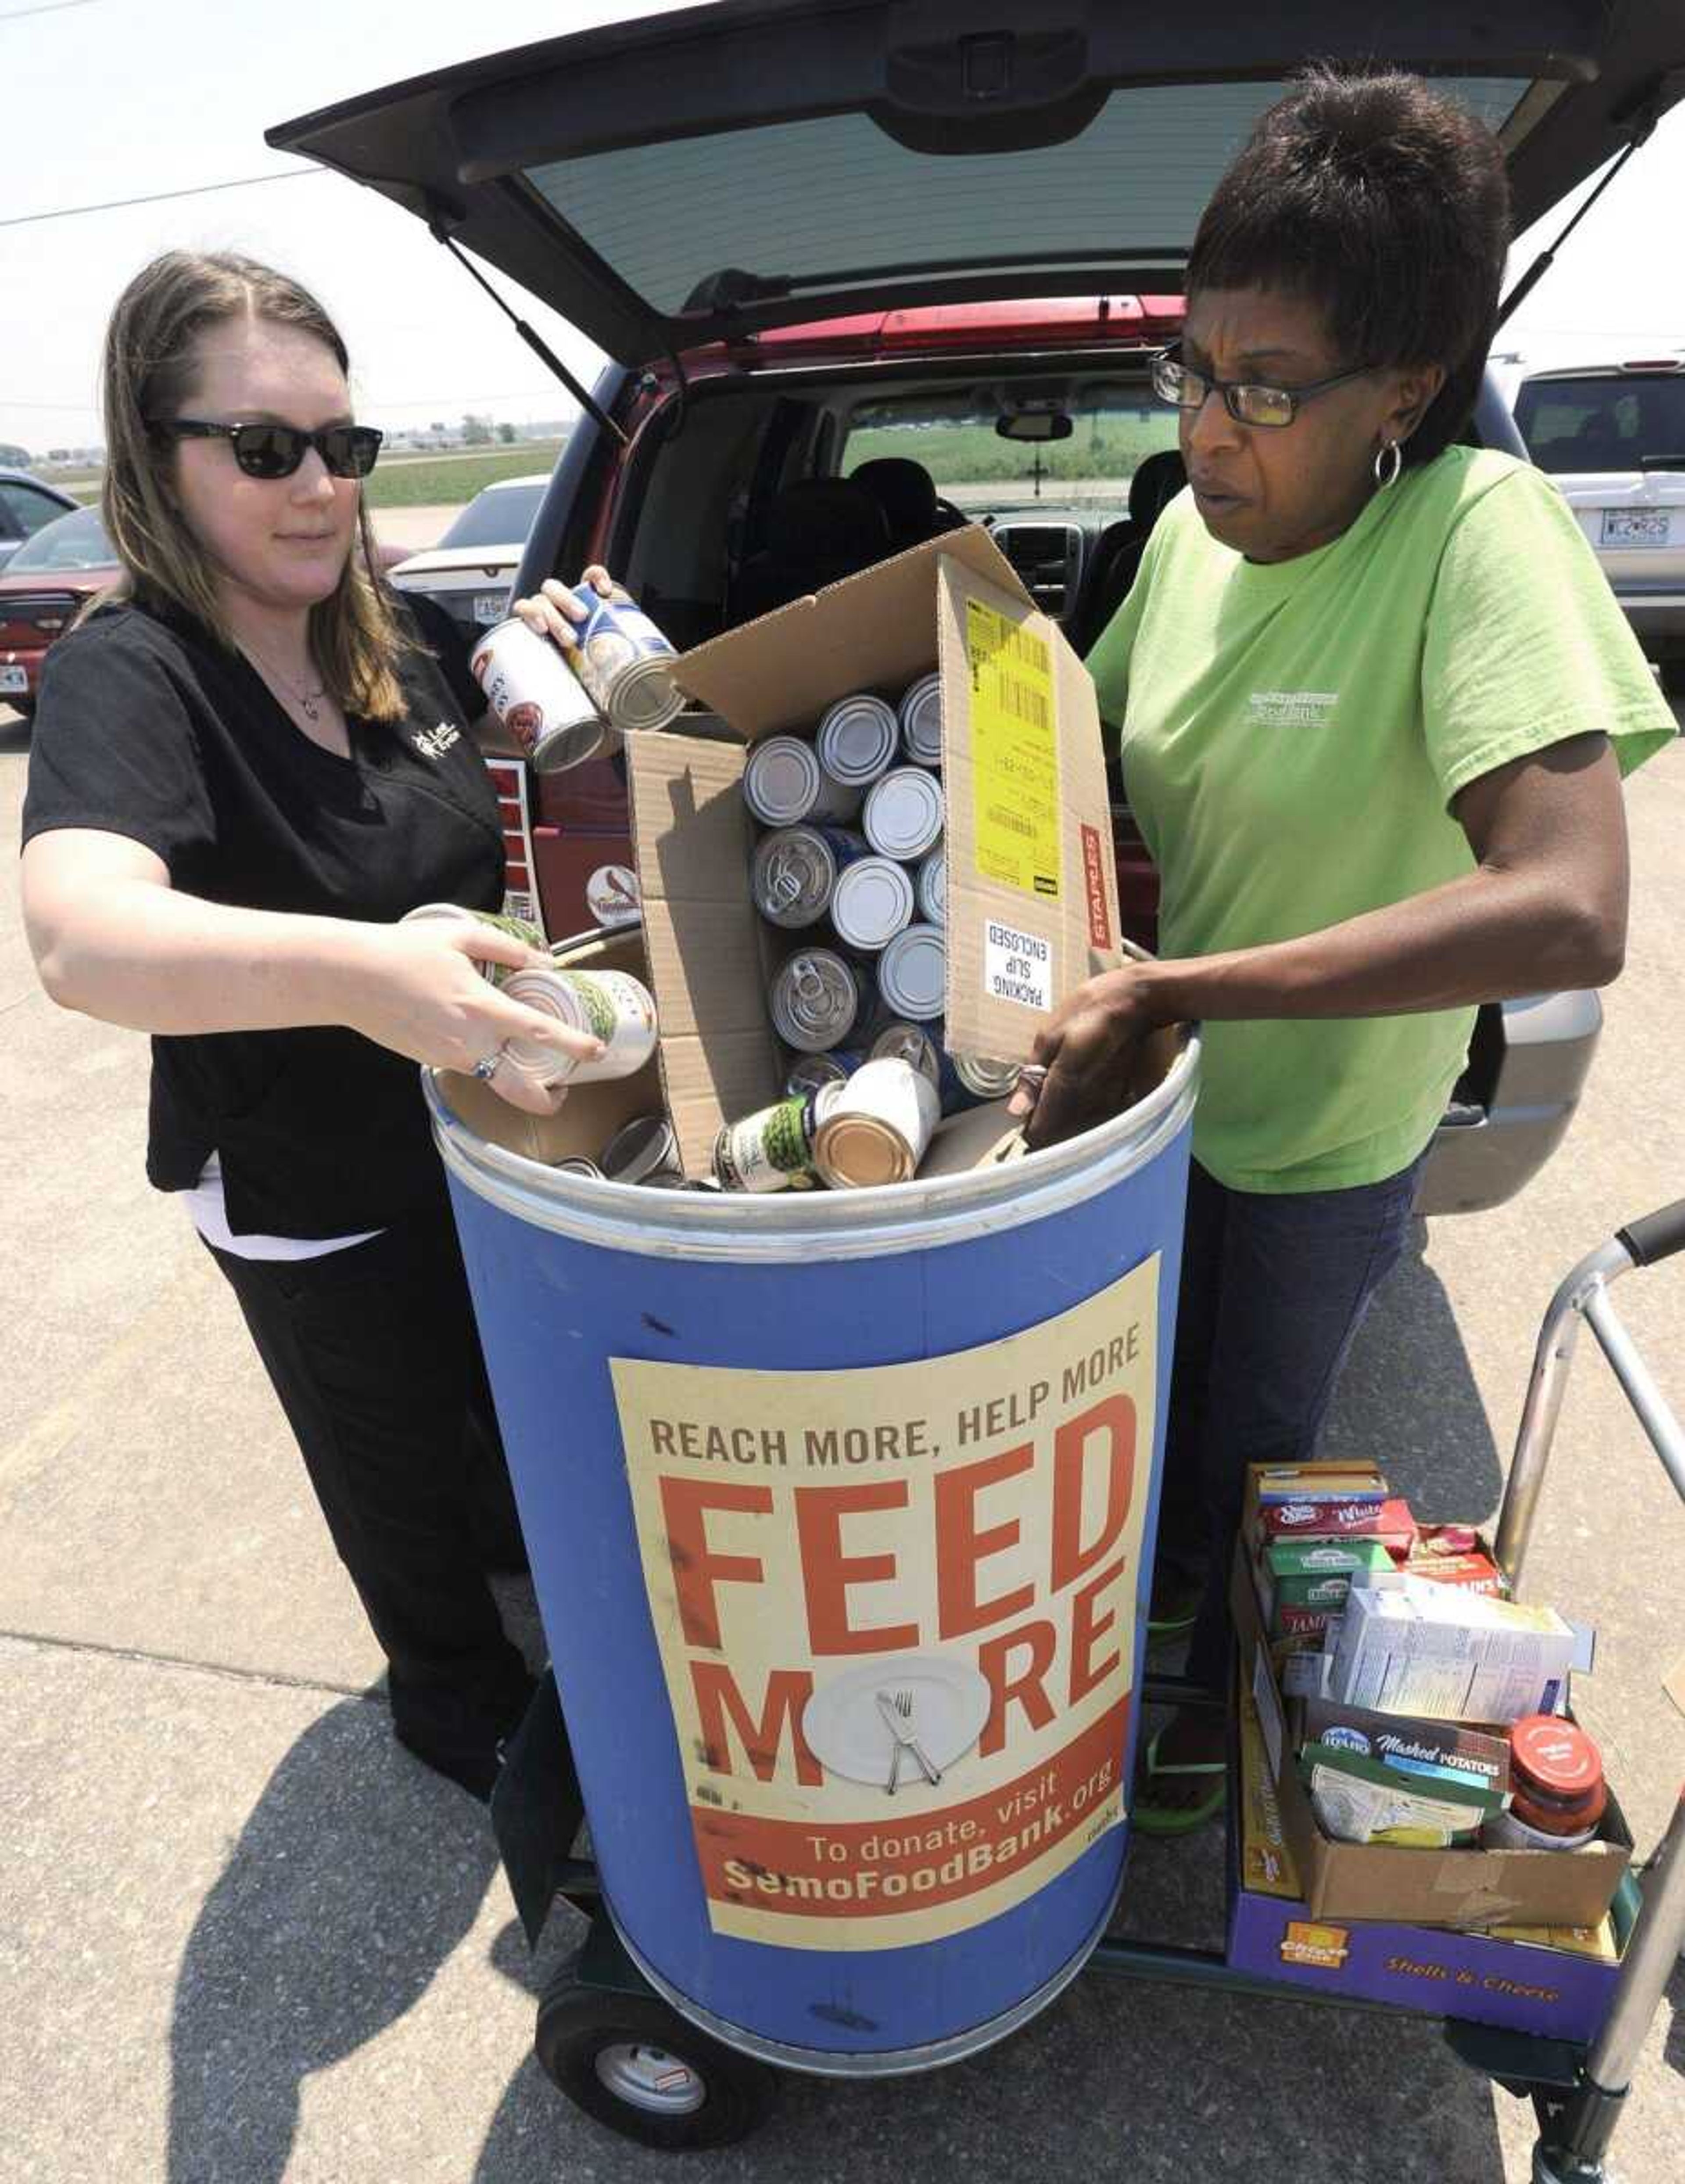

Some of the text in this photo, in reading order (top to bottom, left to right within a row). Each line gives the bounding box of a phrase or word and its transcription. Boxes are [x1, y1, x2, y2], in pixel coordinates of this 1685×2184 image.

[1085, 833, 1106, 939] STAPLES
[989, 925, 1047, 961] ENCLOSED
[1006, 955, 1031, 979] SLIP
[993, 974, 1043, 1006] PACKING
[650, 1322, 1139, 1465] REACH MORE, HELP MORE
[660, 1392, 1137, 1656] FEED
[1376, 1733, 1440, 1761] Mashed
[1440, 1754, 1500, 1776] POTATOES
[723, 1760, 1112, 1900] SemoFoodBank.org
[809, 1836, 847, 1862] To
[997, 1769, 1056, 1824] visit
[1385, 1955, 1559, 2003] Shells & Cheese
